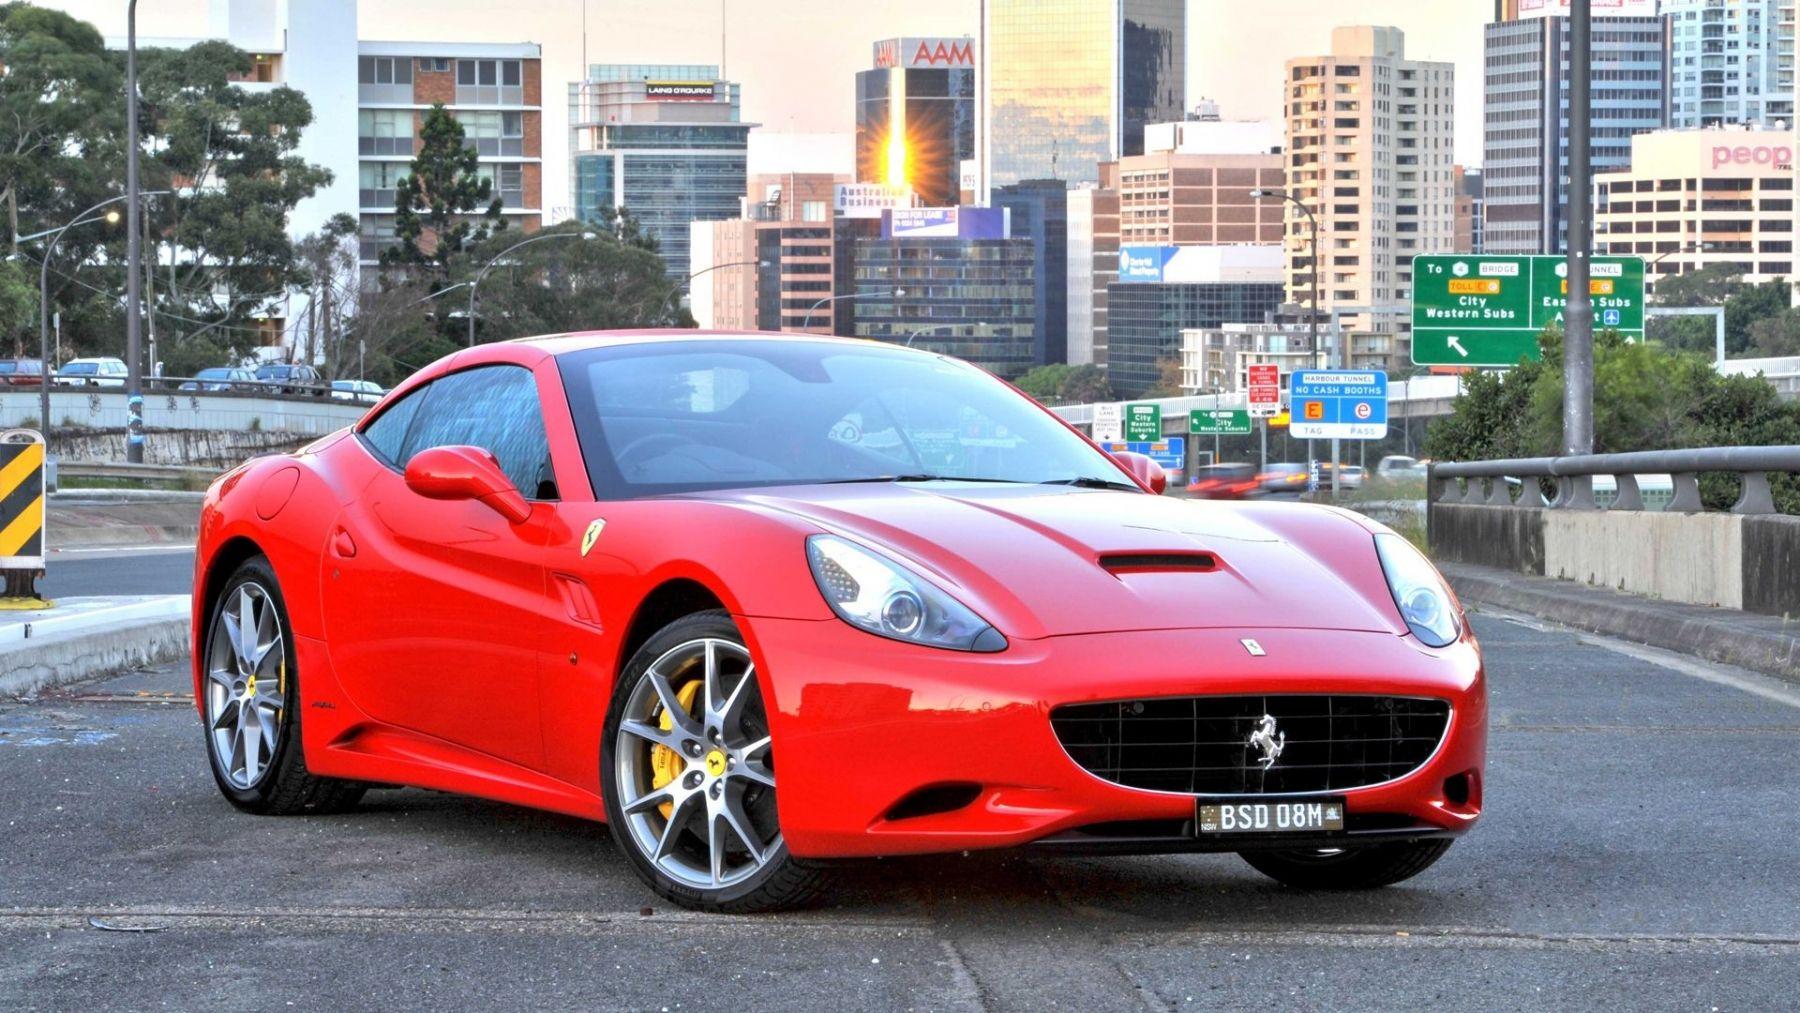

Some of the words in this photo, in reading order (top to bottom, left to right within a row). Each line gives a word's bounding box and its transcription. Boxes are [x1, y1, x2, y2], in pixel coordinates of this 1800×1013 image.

[913, 40, 975, 65] AAM
[1427, 264, 1442, 273] To
[1482, 265, 1516, 273] BRIDGE
[1459, 296, 1487, 308] City
[1599, 297, 1631, 307] Subs
[1426, 308, 1479, 318] Western
[1484, 308, 1515, 318] Subs
[1295, 386, 1309, 394] NO
[1313, 386, 1340, 394] CASH
[1344, 386, 1382, 395] BOOTHS
[1134, 414, 1152, 422] City
[1304, 427, 1323, 435] TAG
[1350, 427, 1377, 435] PASS
[1221, 804, 1269, 829] BSD
[1276, 803, 1322, 828] 08M
